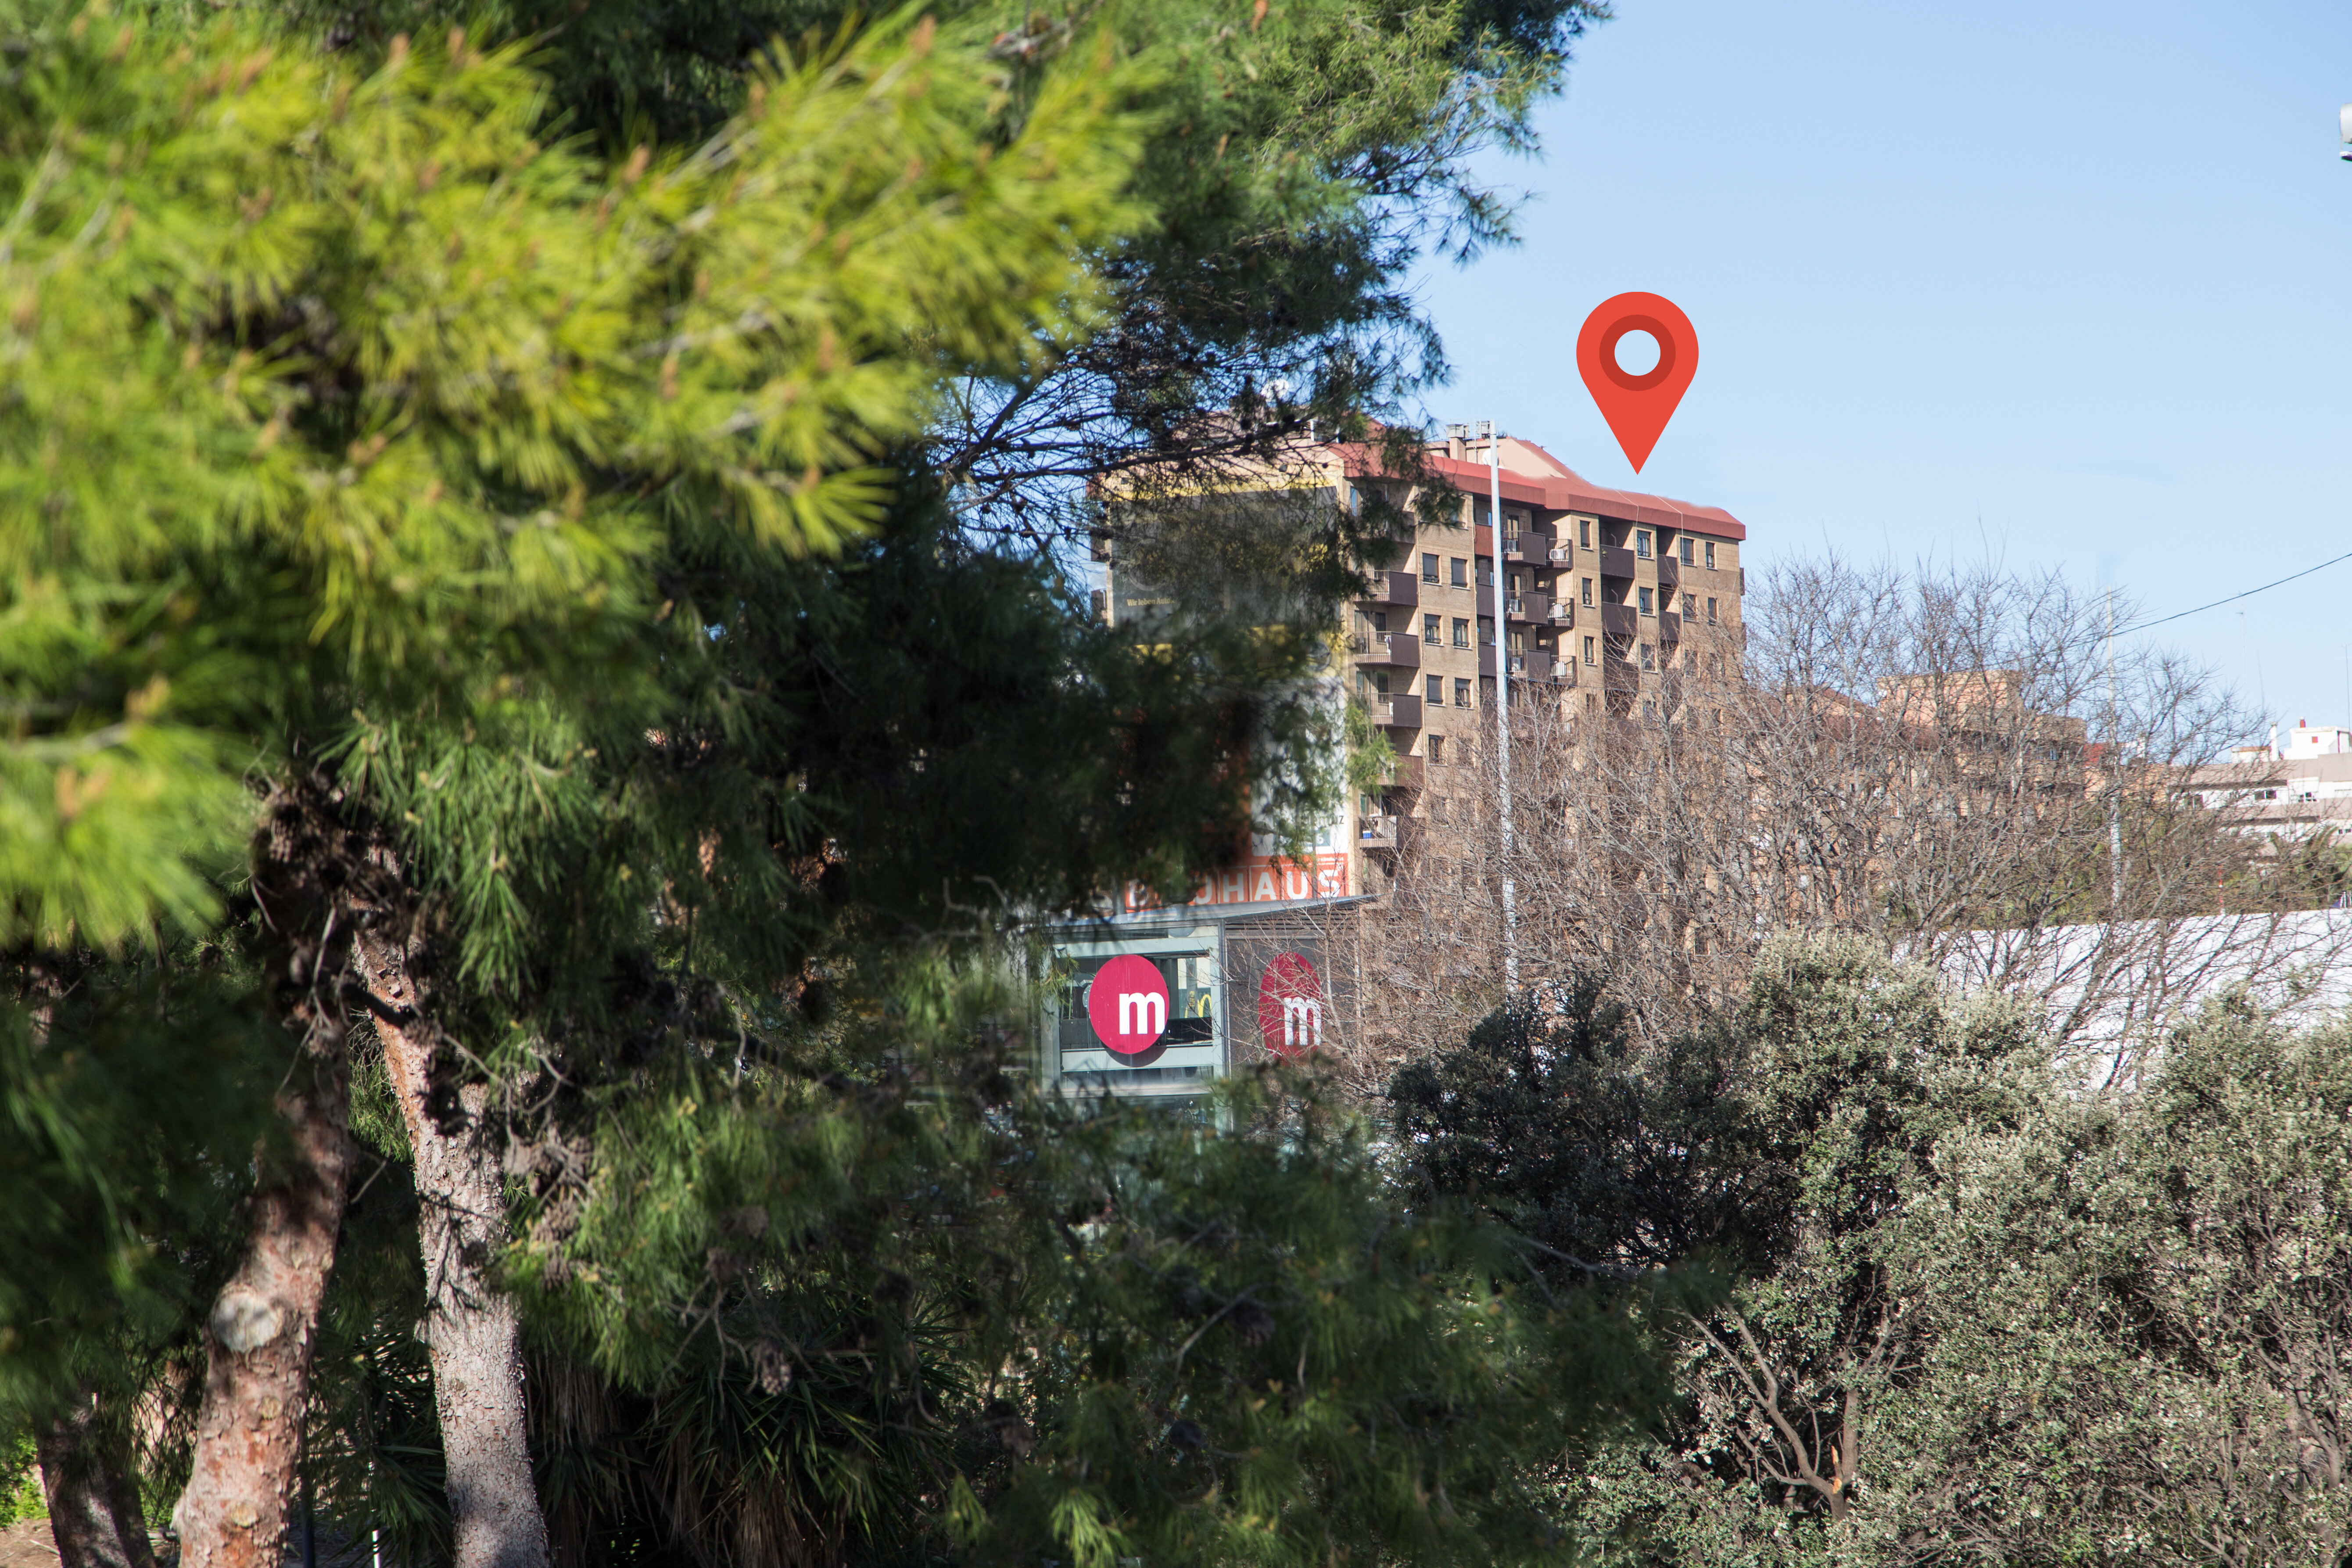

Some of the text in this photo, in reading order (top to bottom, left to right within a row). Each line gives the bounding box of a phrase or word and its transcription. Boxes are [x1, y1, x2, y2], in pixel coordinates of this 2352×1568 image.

[1129, 869, 1340, 907] BUHAUS
[1119, 992, 1165, 1035] m
[1284, 997, 1321, 1045] m
